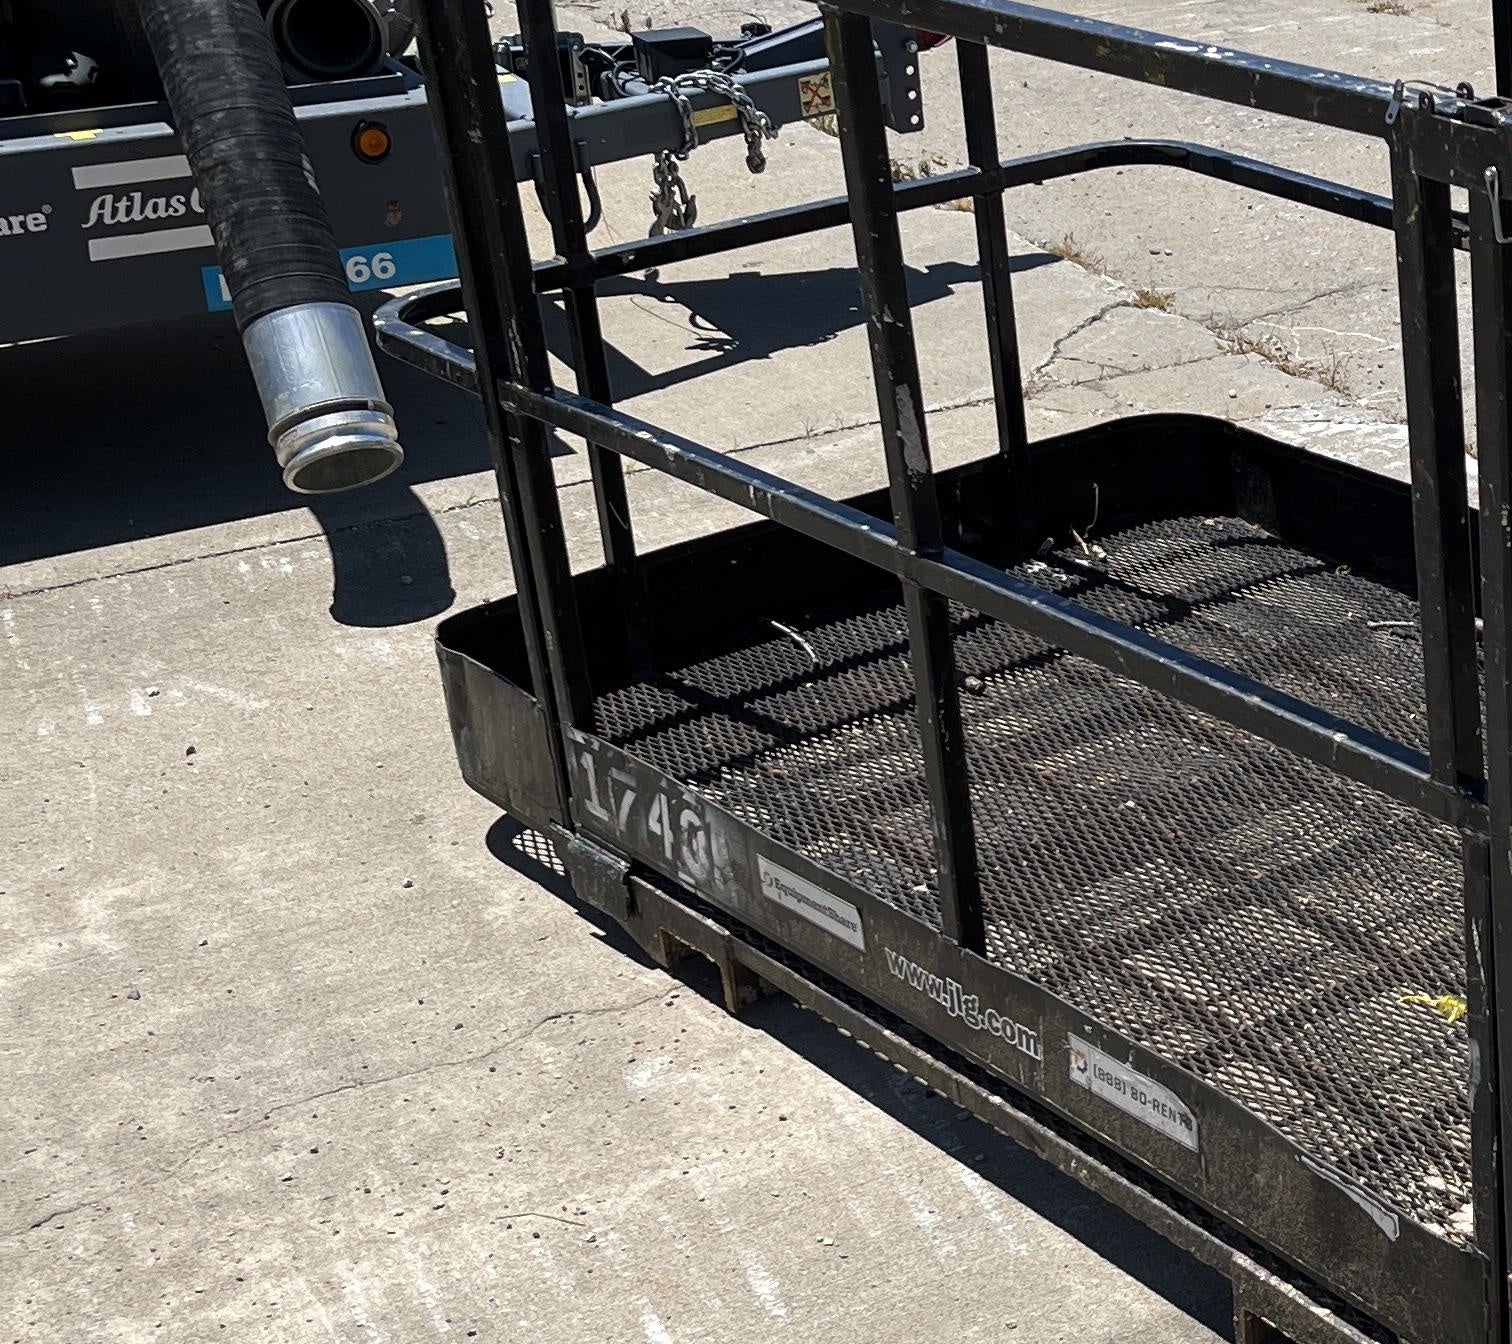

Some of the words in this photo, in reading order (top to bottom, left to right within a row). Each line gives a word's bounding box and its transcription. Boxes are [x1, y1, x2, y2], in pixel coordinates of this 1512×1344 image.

[81, 191, 186, 228] Atlas
[774, 876, 858, 933] EquipmentShare
[884, 946, 1043, 1061] www.jlg.com
[1093, 1063, 1127, 1095] (888)
